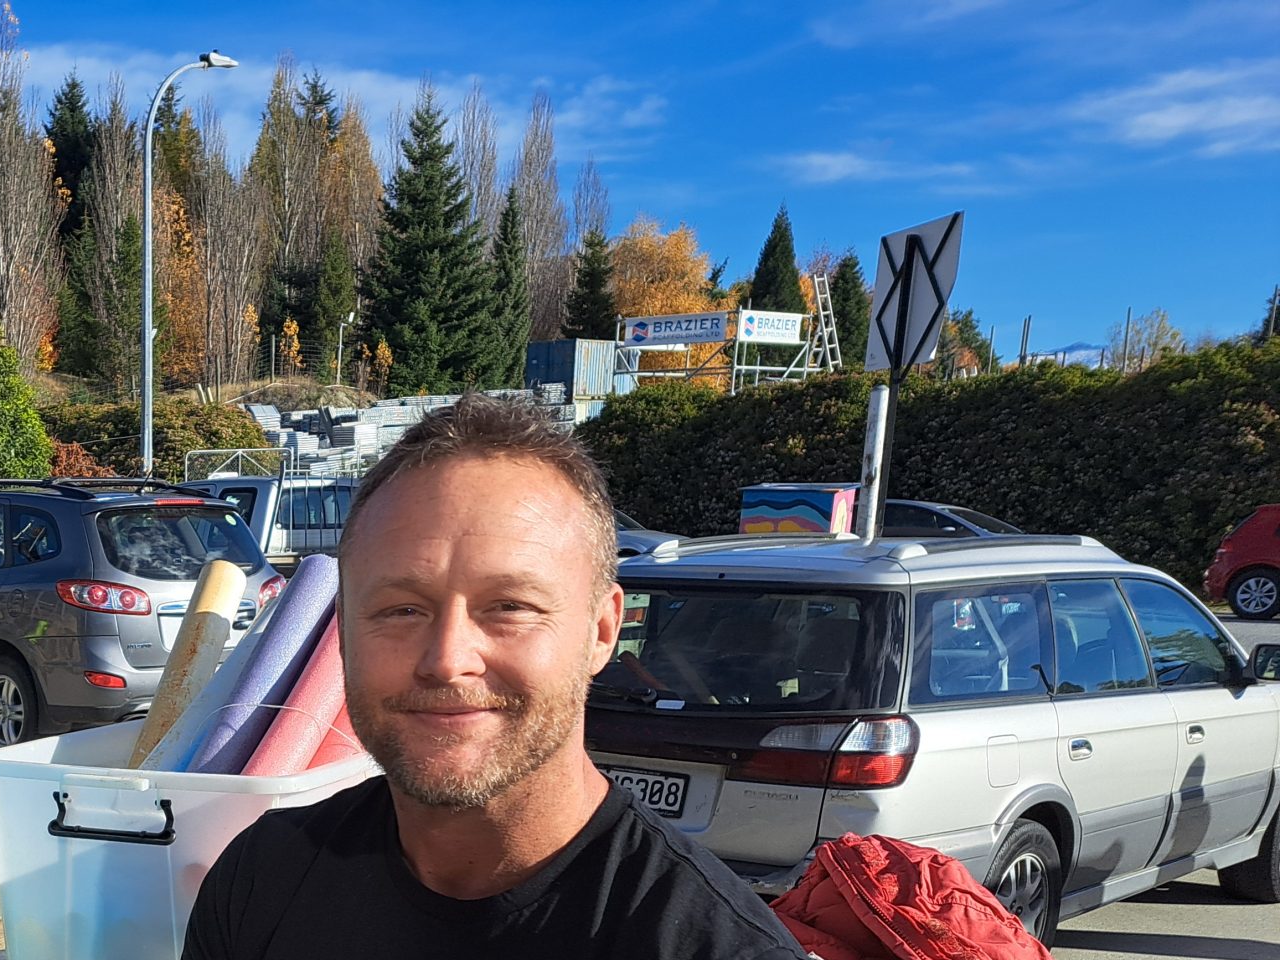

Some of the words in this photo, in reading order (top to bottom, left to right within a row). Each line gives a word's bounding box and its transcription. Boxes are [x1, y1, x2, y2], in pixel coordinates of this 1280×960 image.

[653, 317, 721, 333] BRAZIER
[757, 316, 797, 331] BRAZIER
[653, 332, 703, 340] SCAFFOLDING
